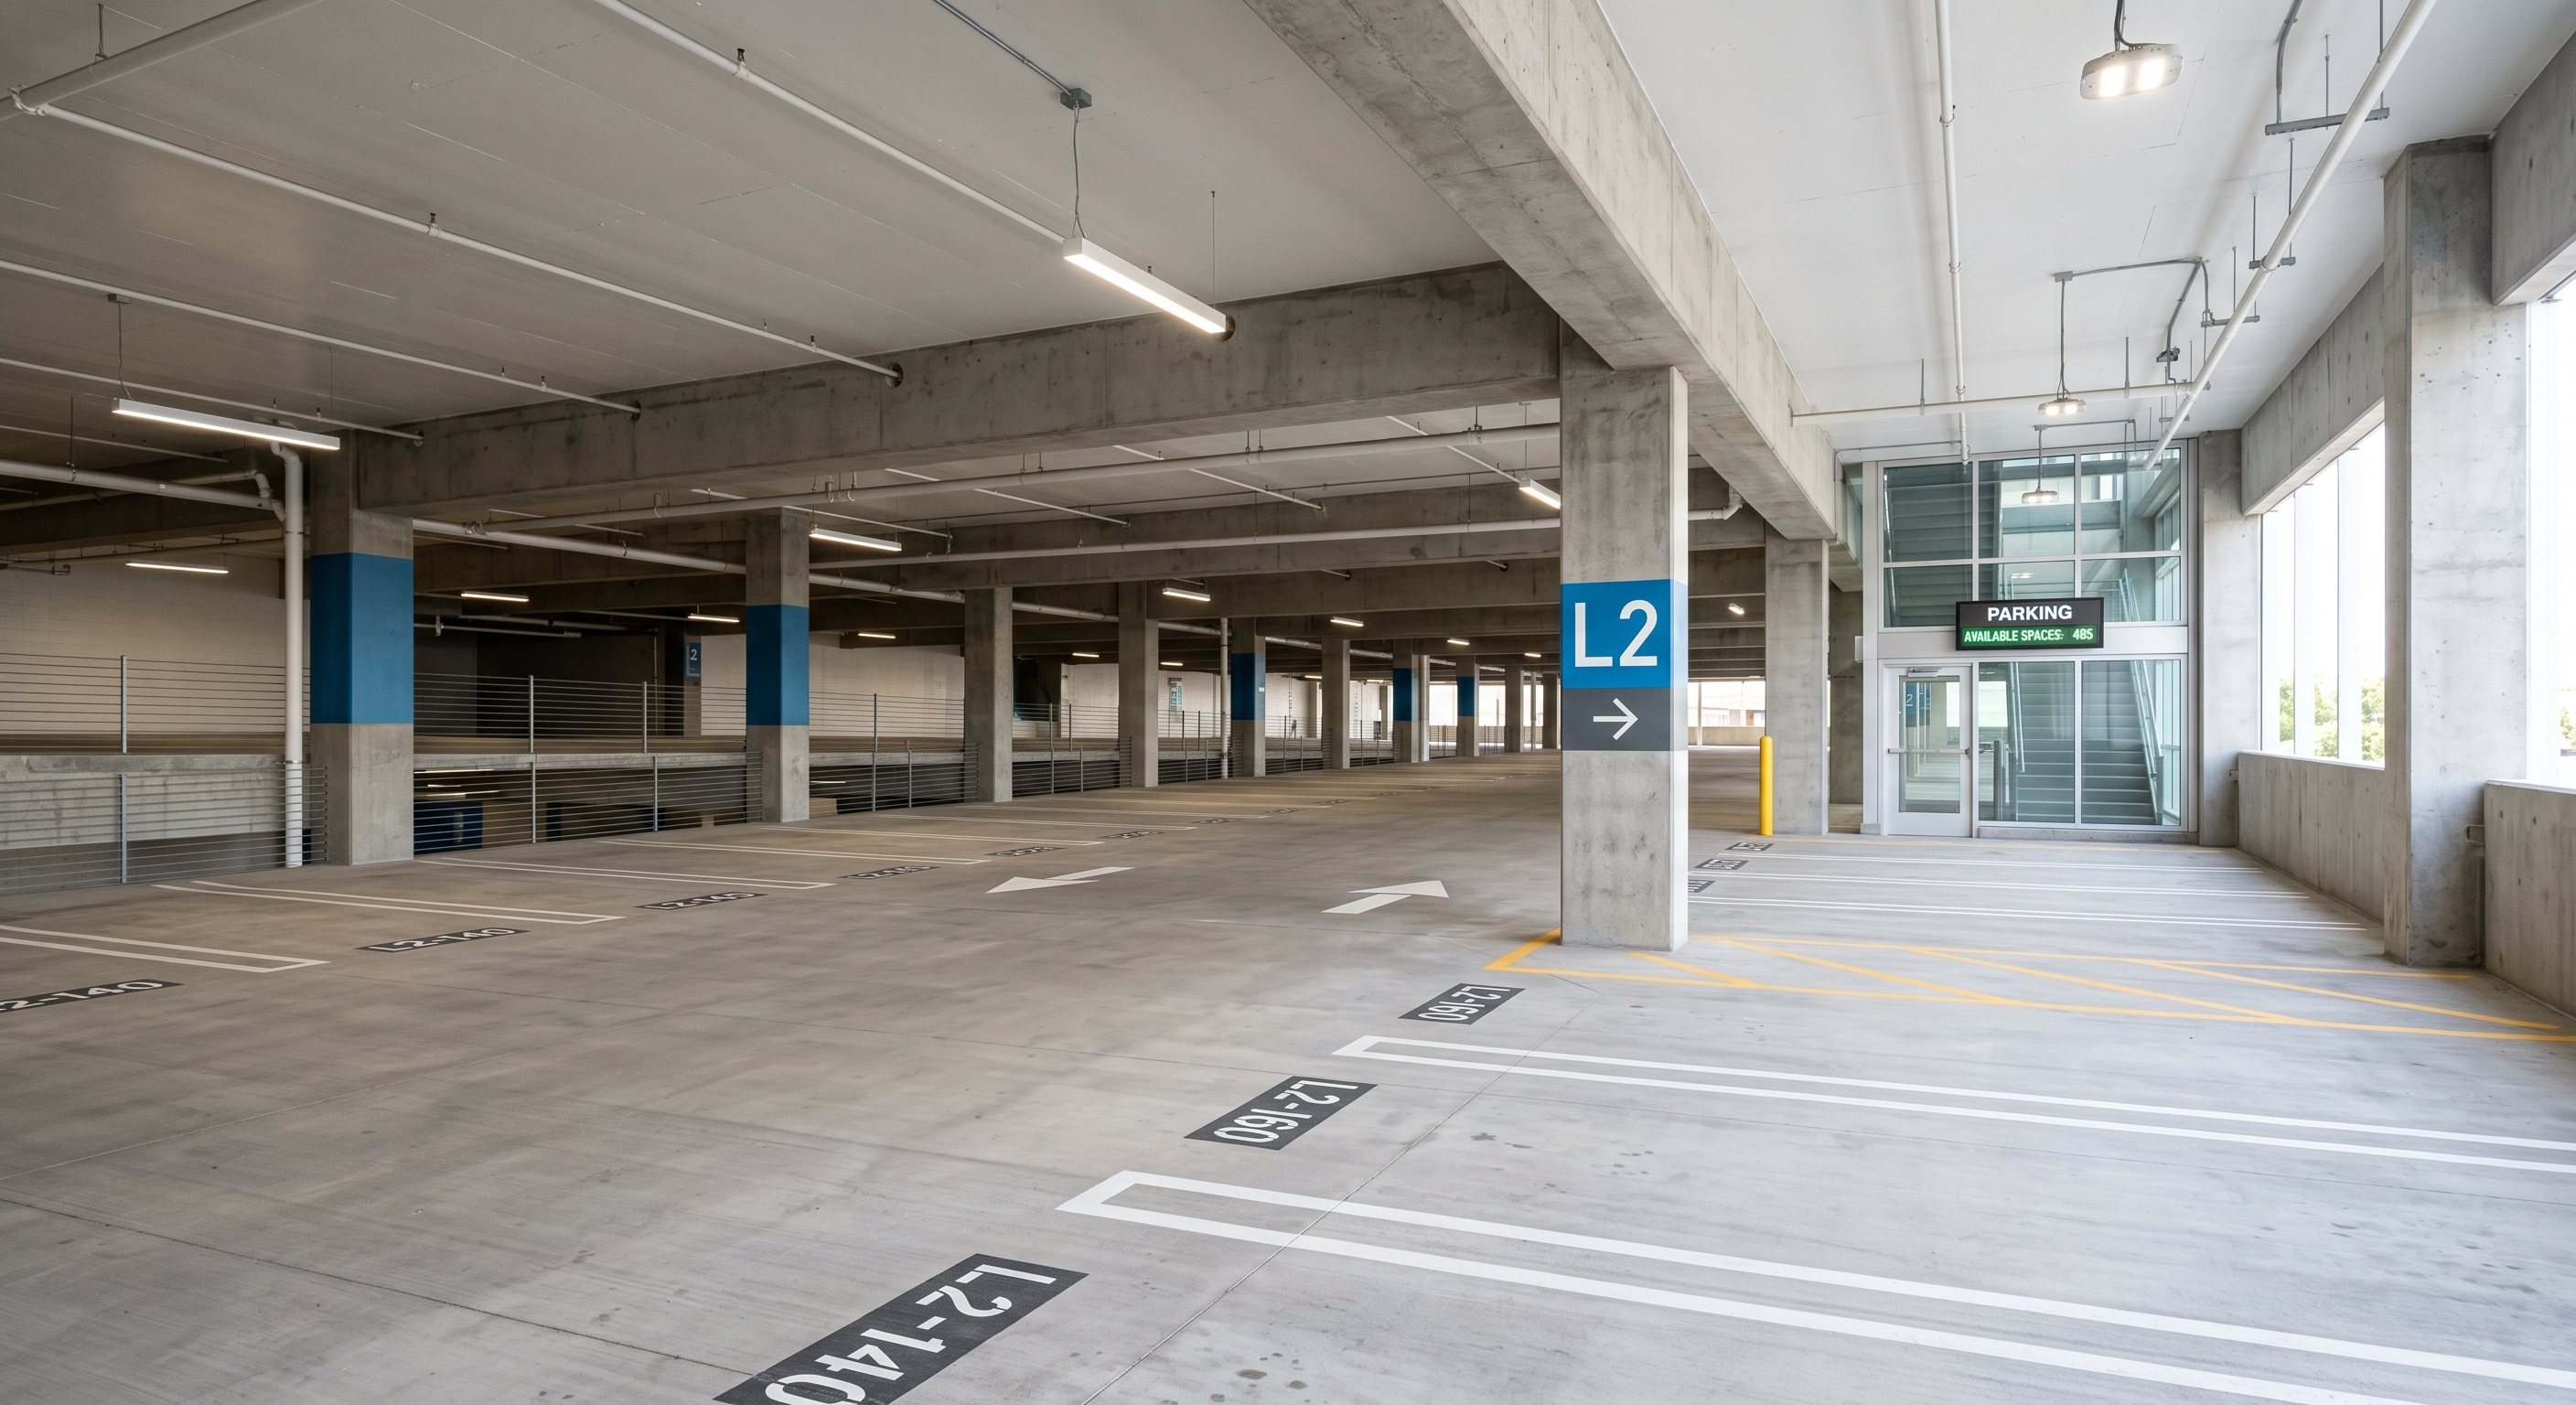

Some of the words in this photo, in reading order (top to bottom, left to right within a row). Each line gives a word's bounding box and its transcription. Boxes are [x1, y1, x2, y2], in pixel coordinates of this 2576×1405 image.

[1987, 605, 2073, 621] PARKING
[1574, 599, 1658, 667] L2
[1964, 629, 2019, 642] AVAILABLE
[2072, 627, 2094, 640] 485
[690, 649, 698, 661] 2
[368, 928, 516, 951] L2-140
[0, 981, 164, 1012] 2-140
[1417, 985, 1511, 1021] L2-160
[1213, 1079, 1359, 1143] L2-160
[765, 1263, 1057, 1405] L2-140
